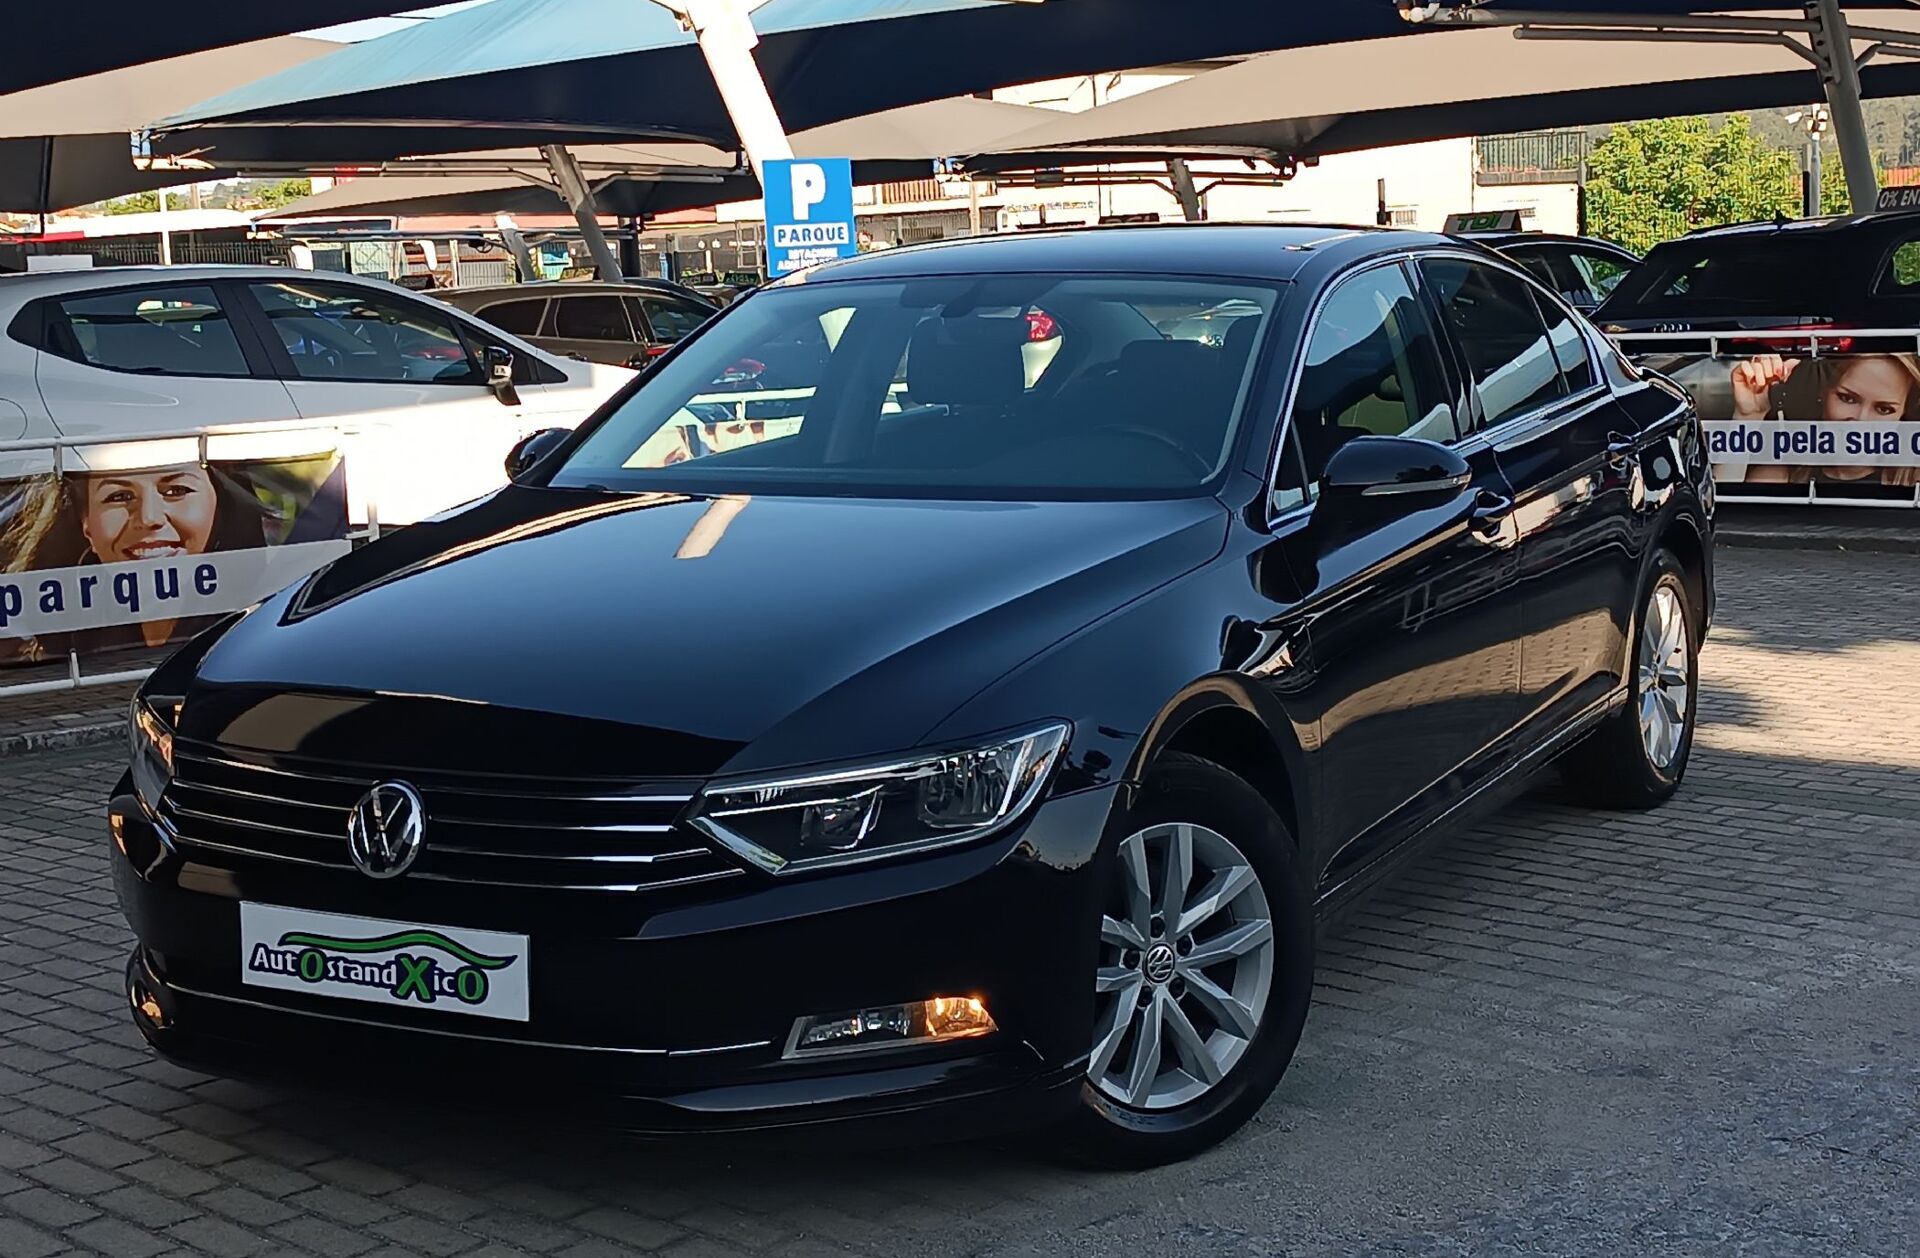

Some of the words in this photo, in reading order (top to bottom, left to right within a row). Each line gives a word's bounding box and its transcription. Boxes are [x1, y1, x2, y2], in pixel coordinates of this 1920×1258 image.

[790, 163, 826, 220] P
[1879, 190, 1899, 208] 0%
[777, 226, 845, 243] PARQUE
[1457, 213, 1503, 231] TDI
[1773, 424, 1835, 459] pela
[1846, 430, 1900, 454] sua
[0, 563, 218, 627] parque
